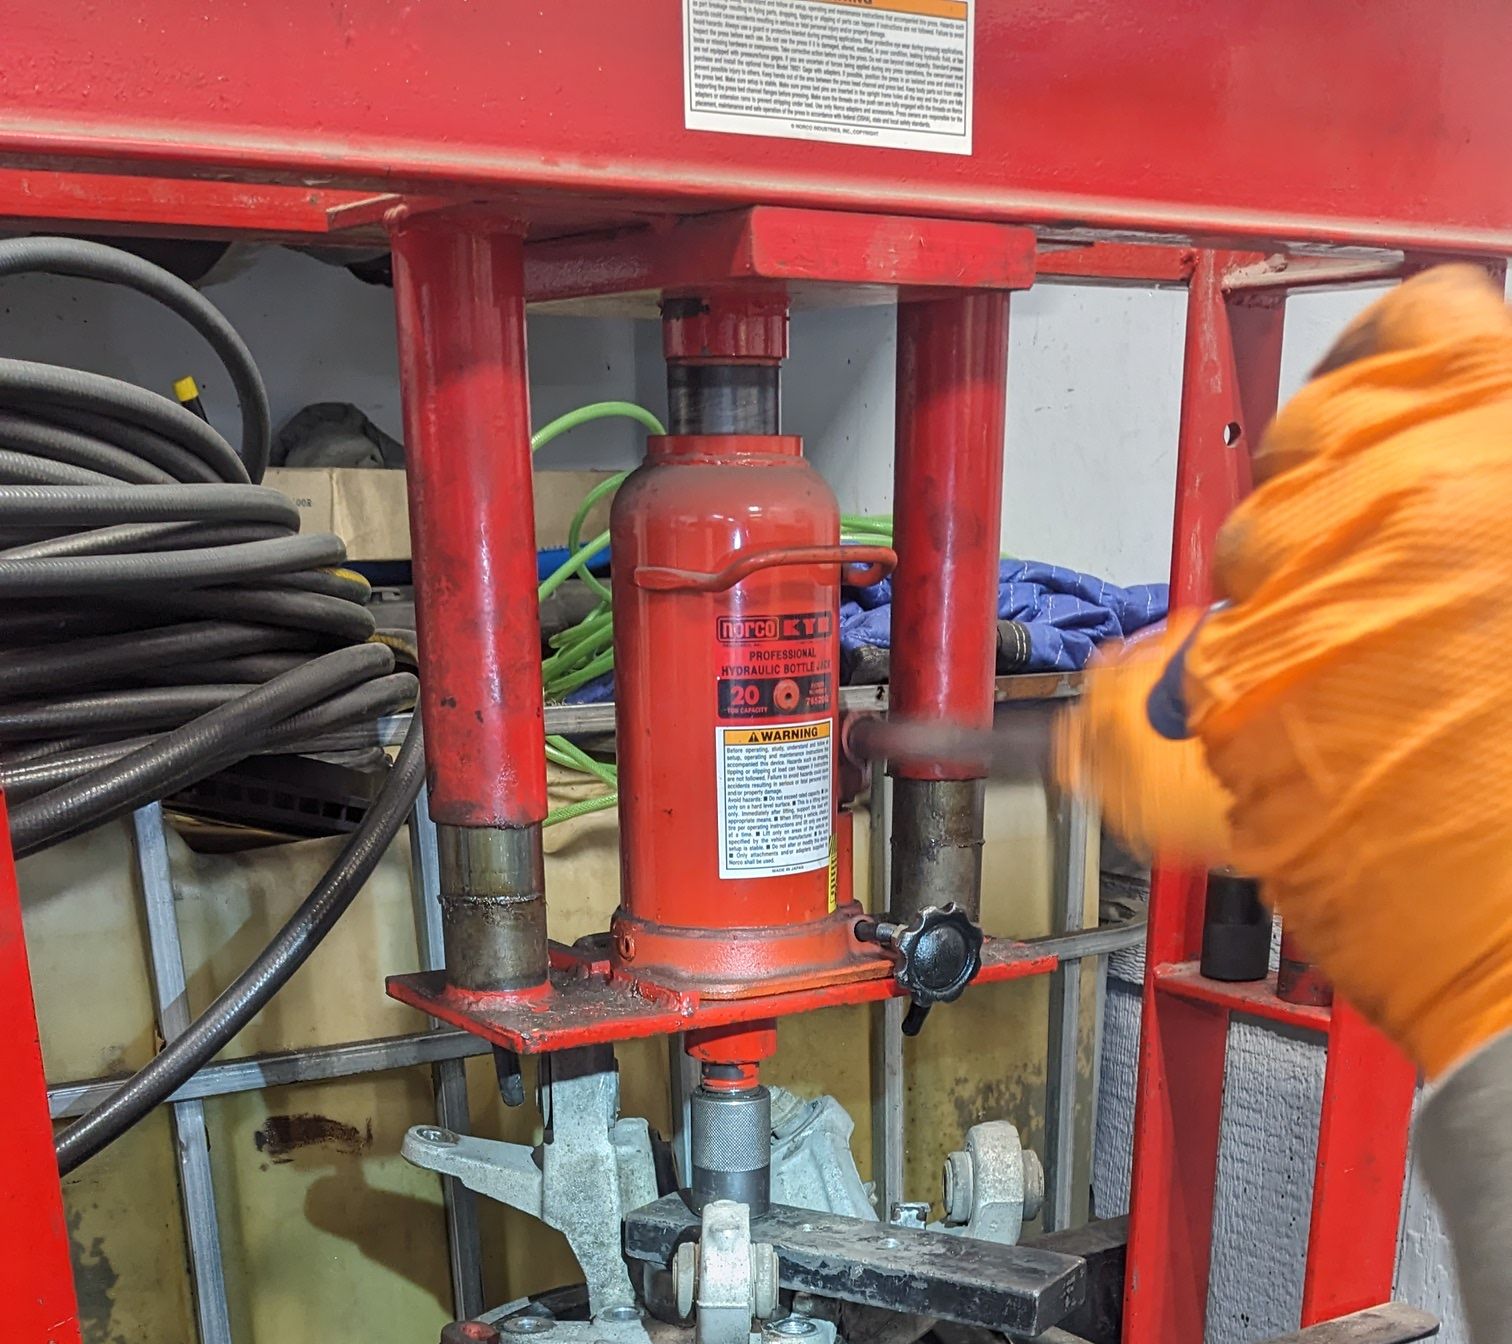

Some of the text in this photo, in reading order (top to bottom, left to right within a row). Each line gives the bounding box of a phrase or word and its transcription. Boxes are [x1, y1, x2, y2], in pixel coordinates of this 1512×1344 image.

[722, 620, 777, 637] norco
[749, 648, 816, 660] PROFESSIONAL
[721, 665, 780, 676] HYDRAULIC
[784, 662, 815, 674] BOTTLE
[730, 685, 760, 705] 20
[760, 727, 818, 742] WARNING
